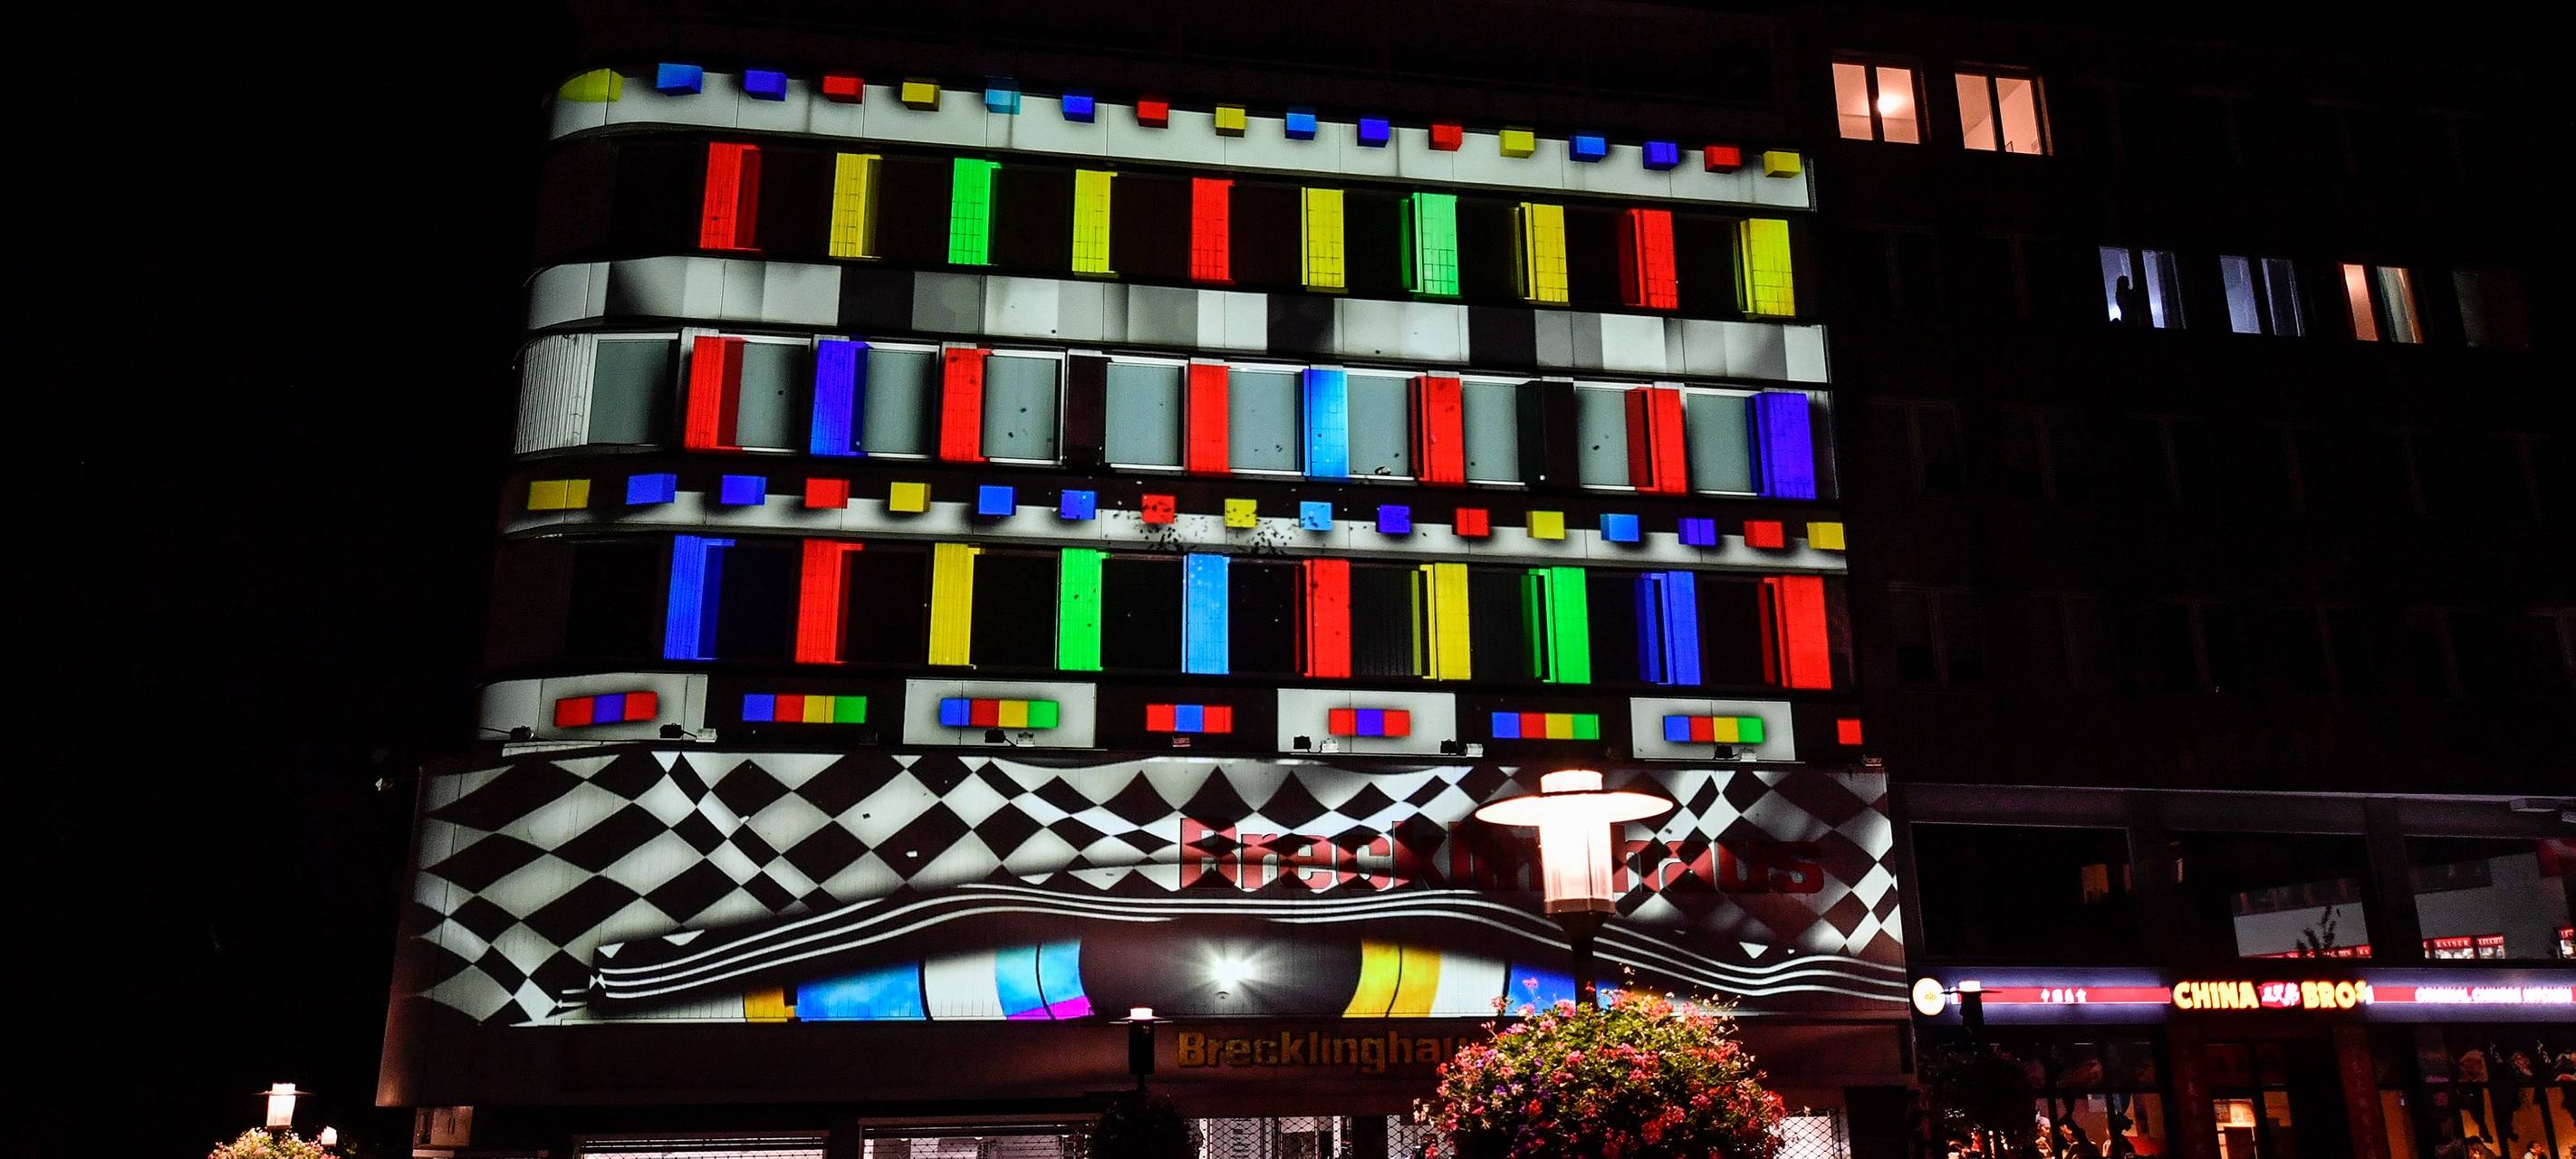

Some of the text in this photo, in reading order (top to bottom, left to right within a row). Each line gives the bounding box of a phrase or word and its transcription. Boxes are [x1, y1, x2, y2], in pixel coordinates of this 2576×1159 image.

[1179, 817, 1824, 894] Brecklinhaus
[2173, 981, 2259, 1009] CHINA
[1178, 1030, 1485, 1074] Brecklinghau
